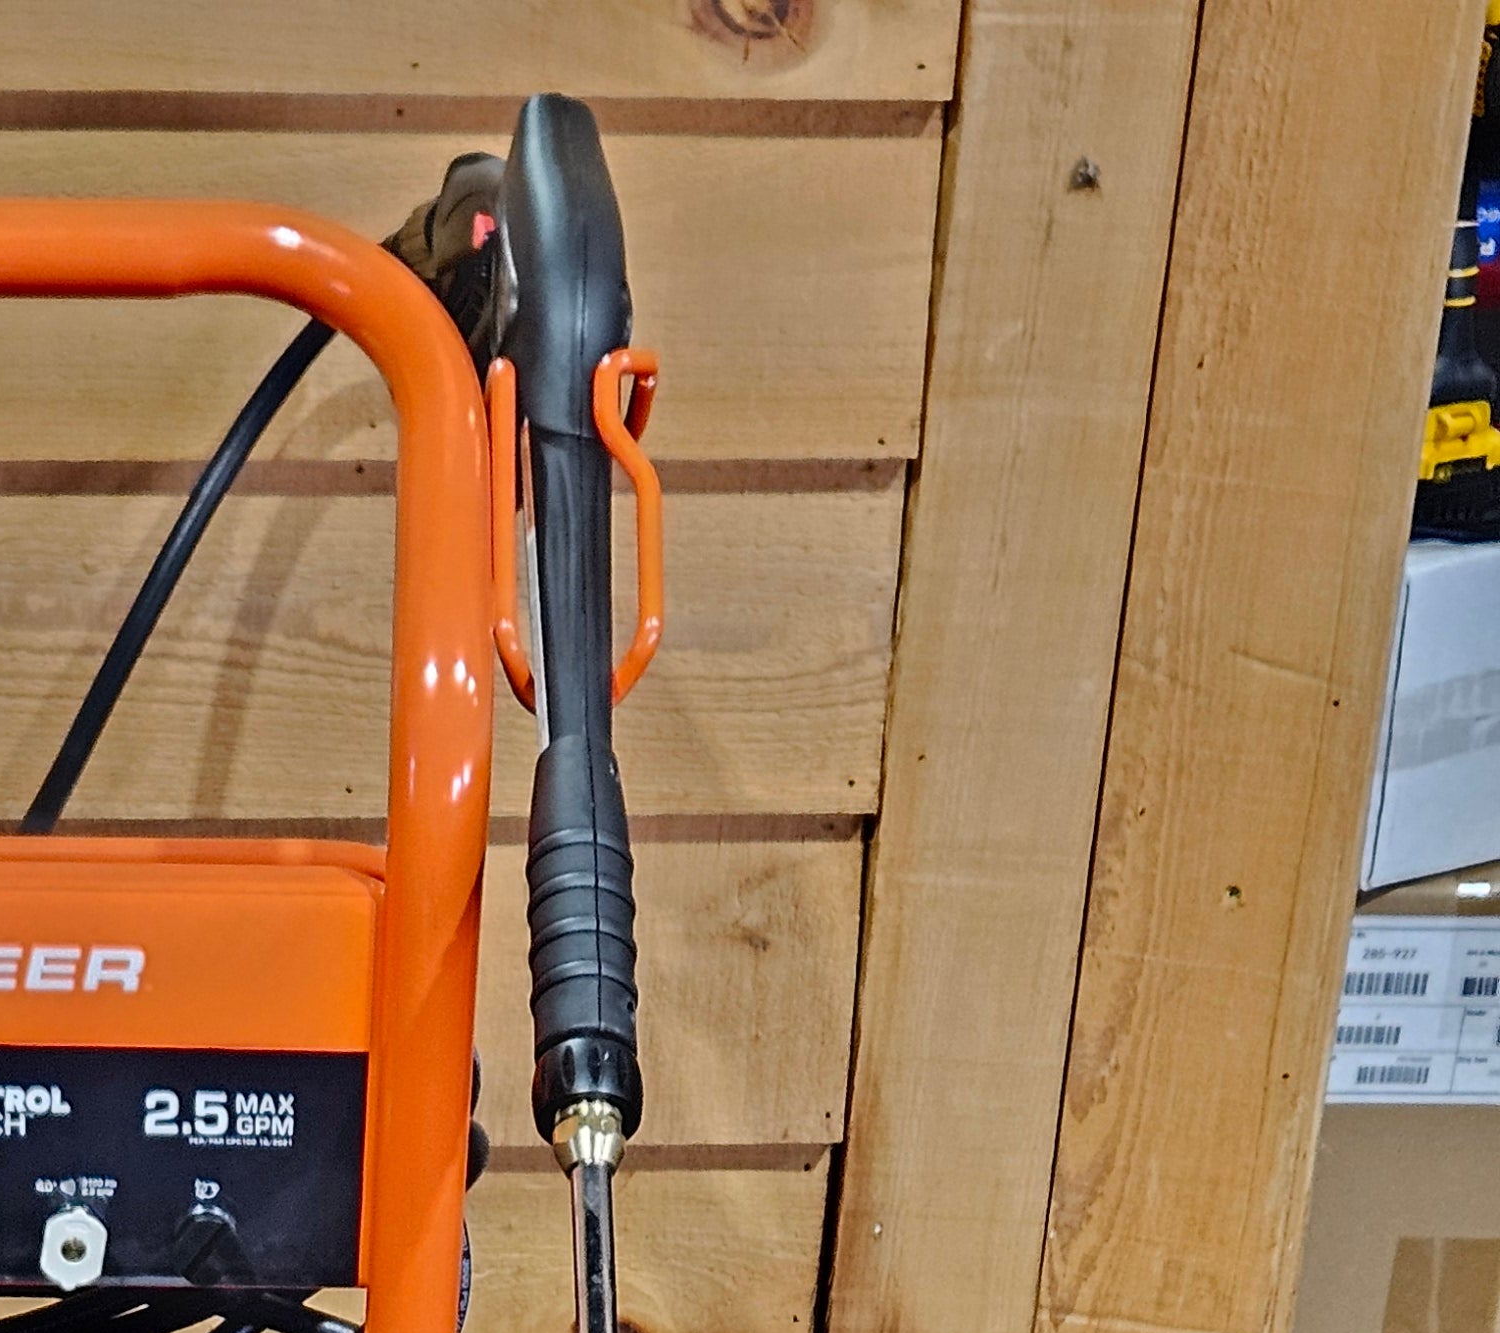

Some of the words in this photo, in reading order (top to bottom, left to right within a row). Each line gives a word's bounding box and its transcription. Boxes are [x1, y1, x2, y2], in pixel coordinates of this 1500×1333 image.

[144, 1089, 229, 1136] 2.5
[235, 1092, 295, 1116] MAX
[236, 1115, 295, 1137] GPM
